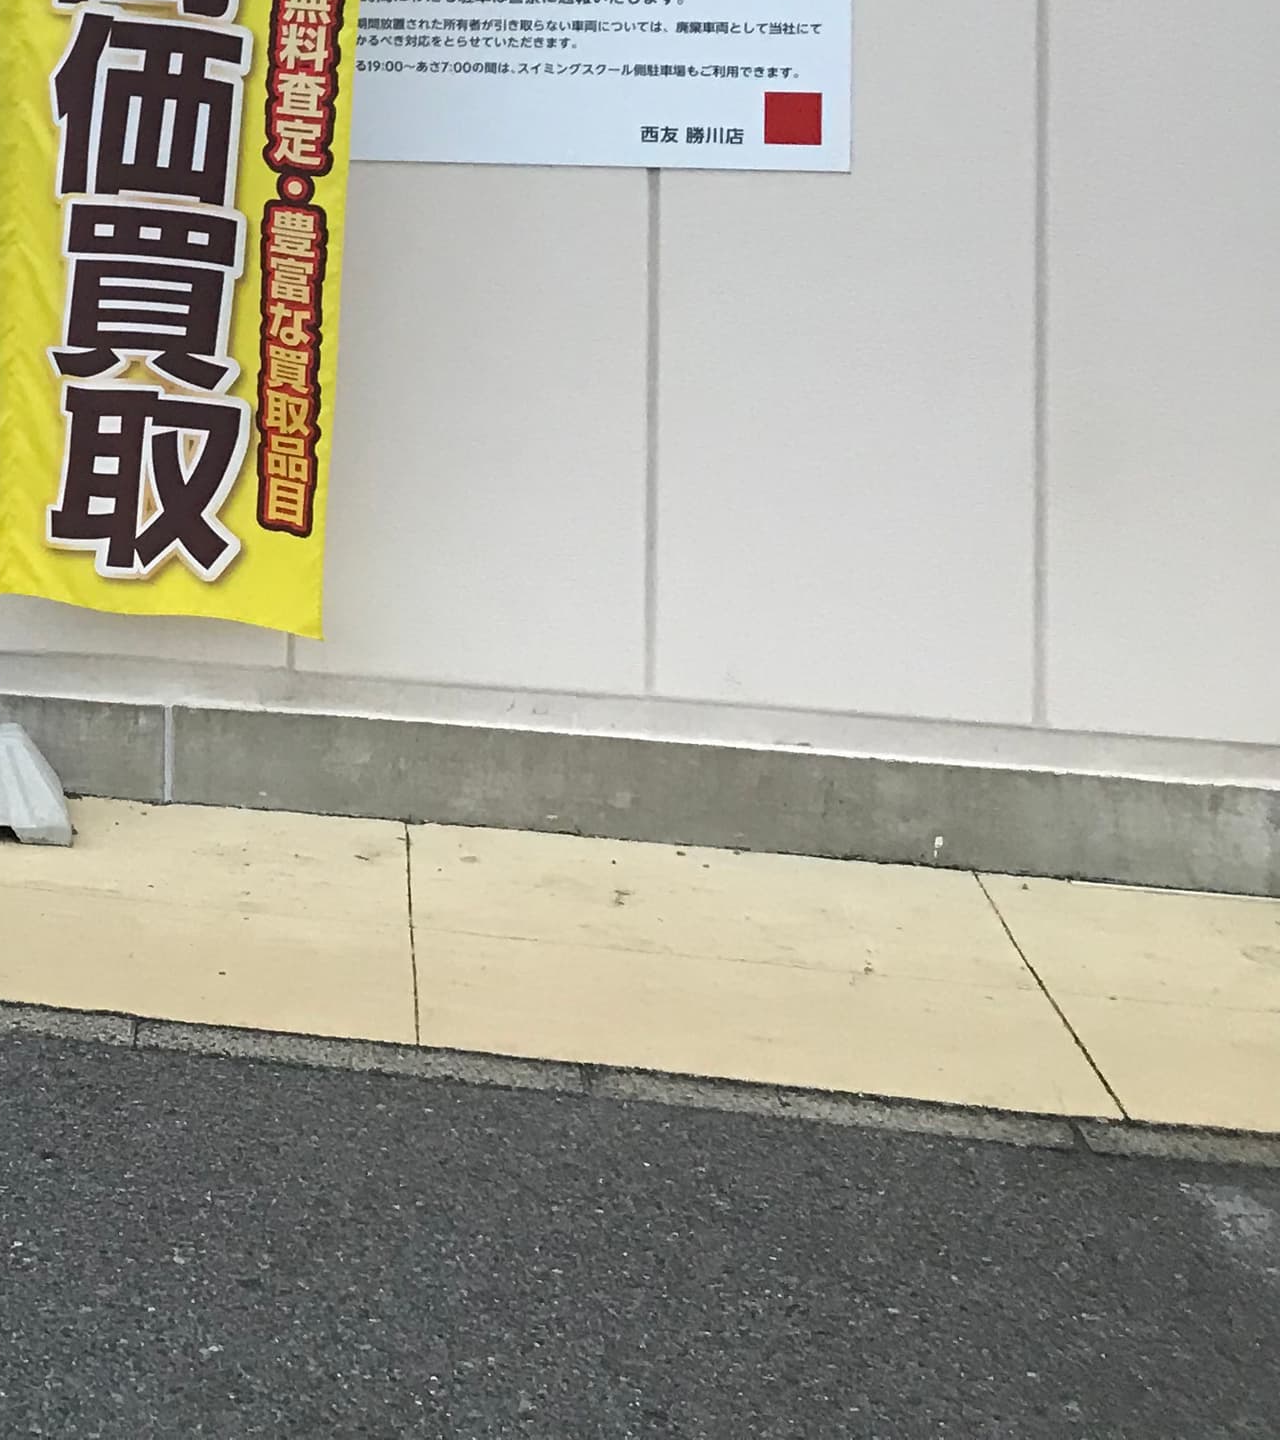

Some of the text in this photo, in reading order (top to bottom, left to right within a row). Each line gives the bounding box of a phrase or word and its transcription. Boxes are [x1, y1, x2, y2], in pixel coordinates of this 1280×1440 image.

[641, 126, 744, 145] 西友 勝川店
